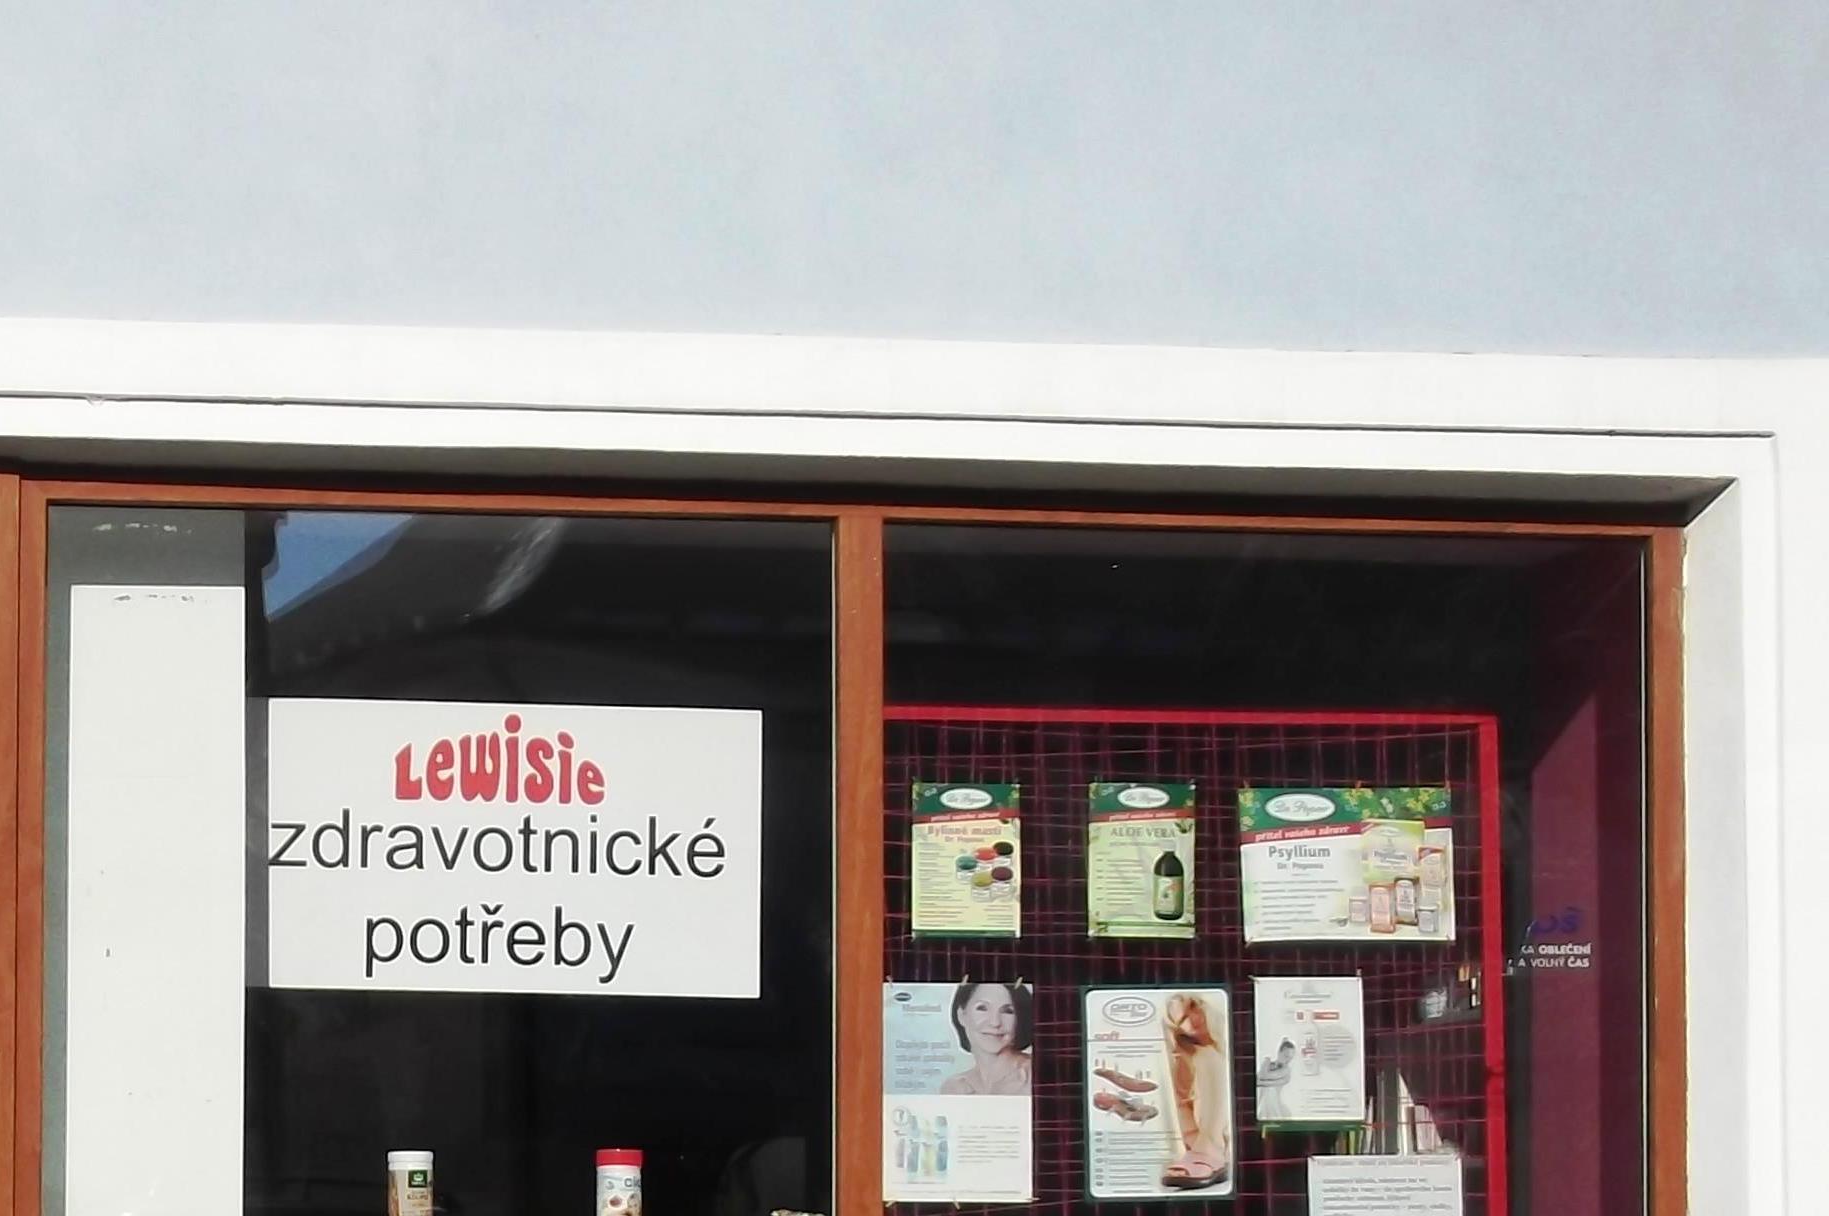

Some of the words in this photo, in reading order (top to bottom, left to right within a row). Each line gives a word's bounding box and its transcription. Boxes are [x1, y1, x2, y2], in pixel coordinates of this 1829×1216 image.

[268, 808, 727, 878] zdravotnické
[1268, 845, 1331, 861] Psyllium
[364, 903, 635, 984] potřeby
[1567, 955, 1590, 968] ČAS
